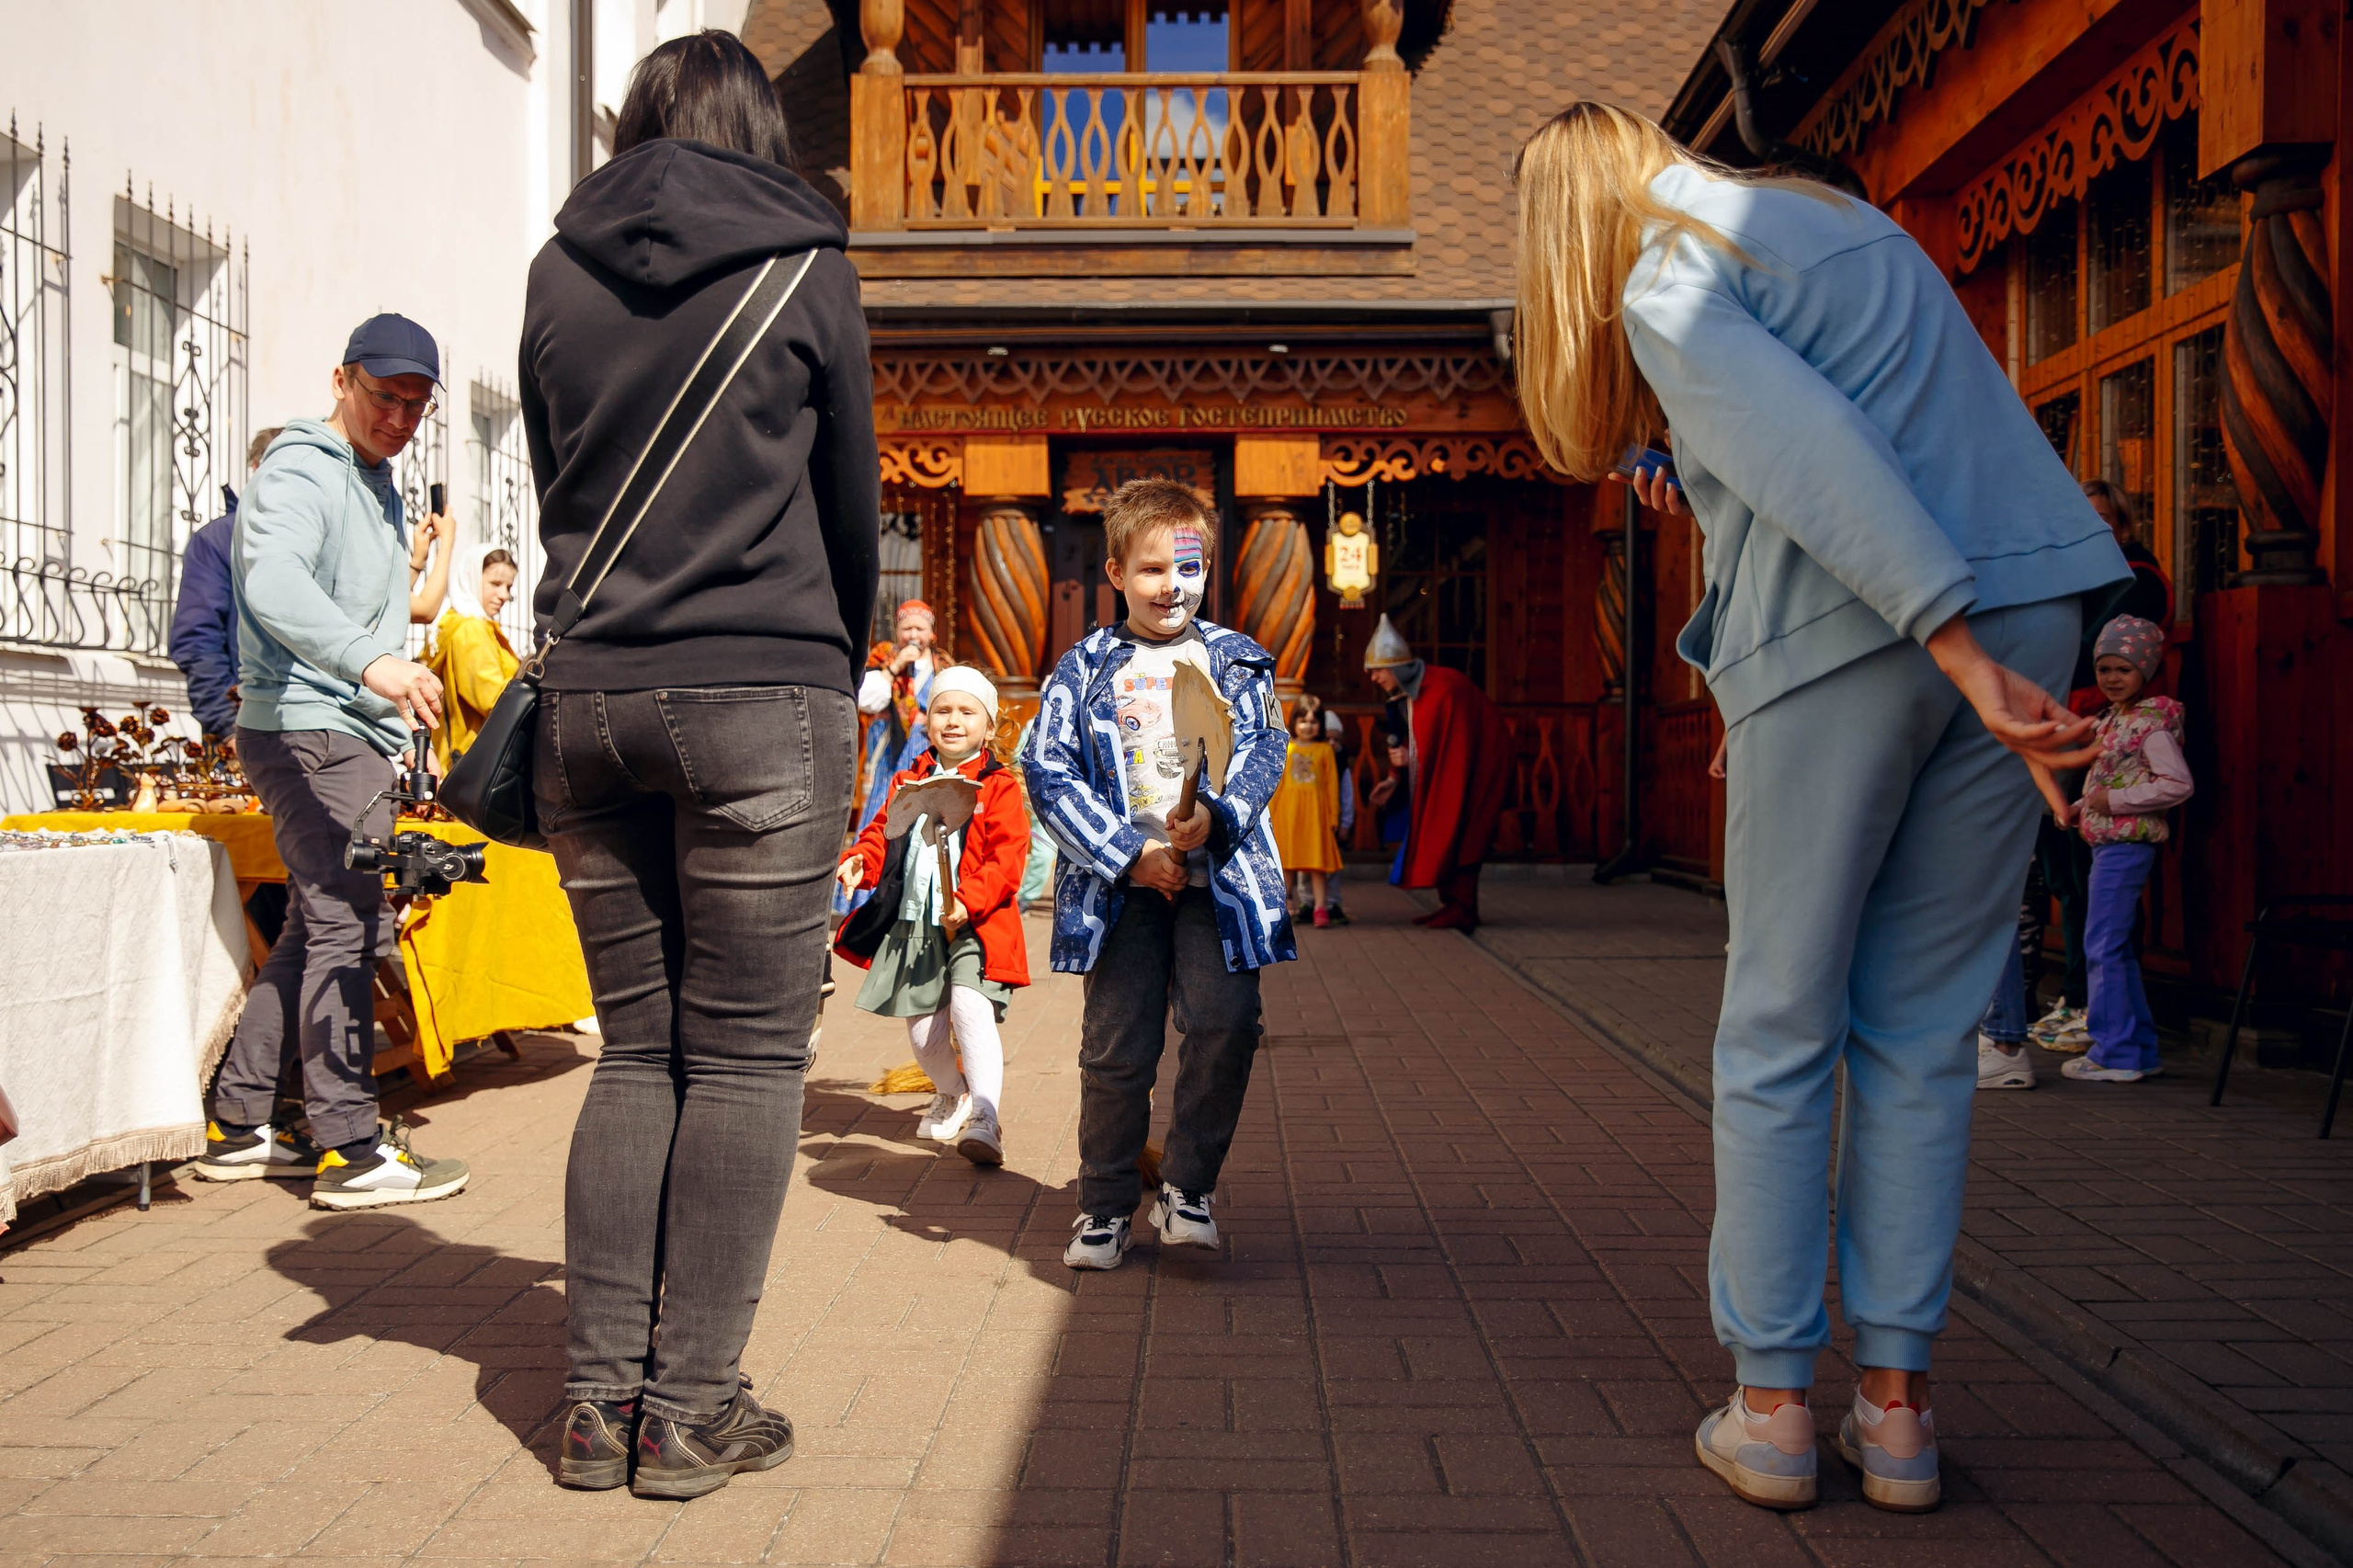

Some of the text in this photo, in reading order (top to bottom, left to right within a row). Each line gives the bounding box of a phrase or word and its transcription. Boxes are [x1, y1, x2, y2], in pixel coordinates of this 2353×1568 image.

[899, 407, 1050, 432] НАСТОЯЩЕЕ
[1060, 407, 1170, 433] РУССКОЕ
[1339, 545, 1361, 562] 24
